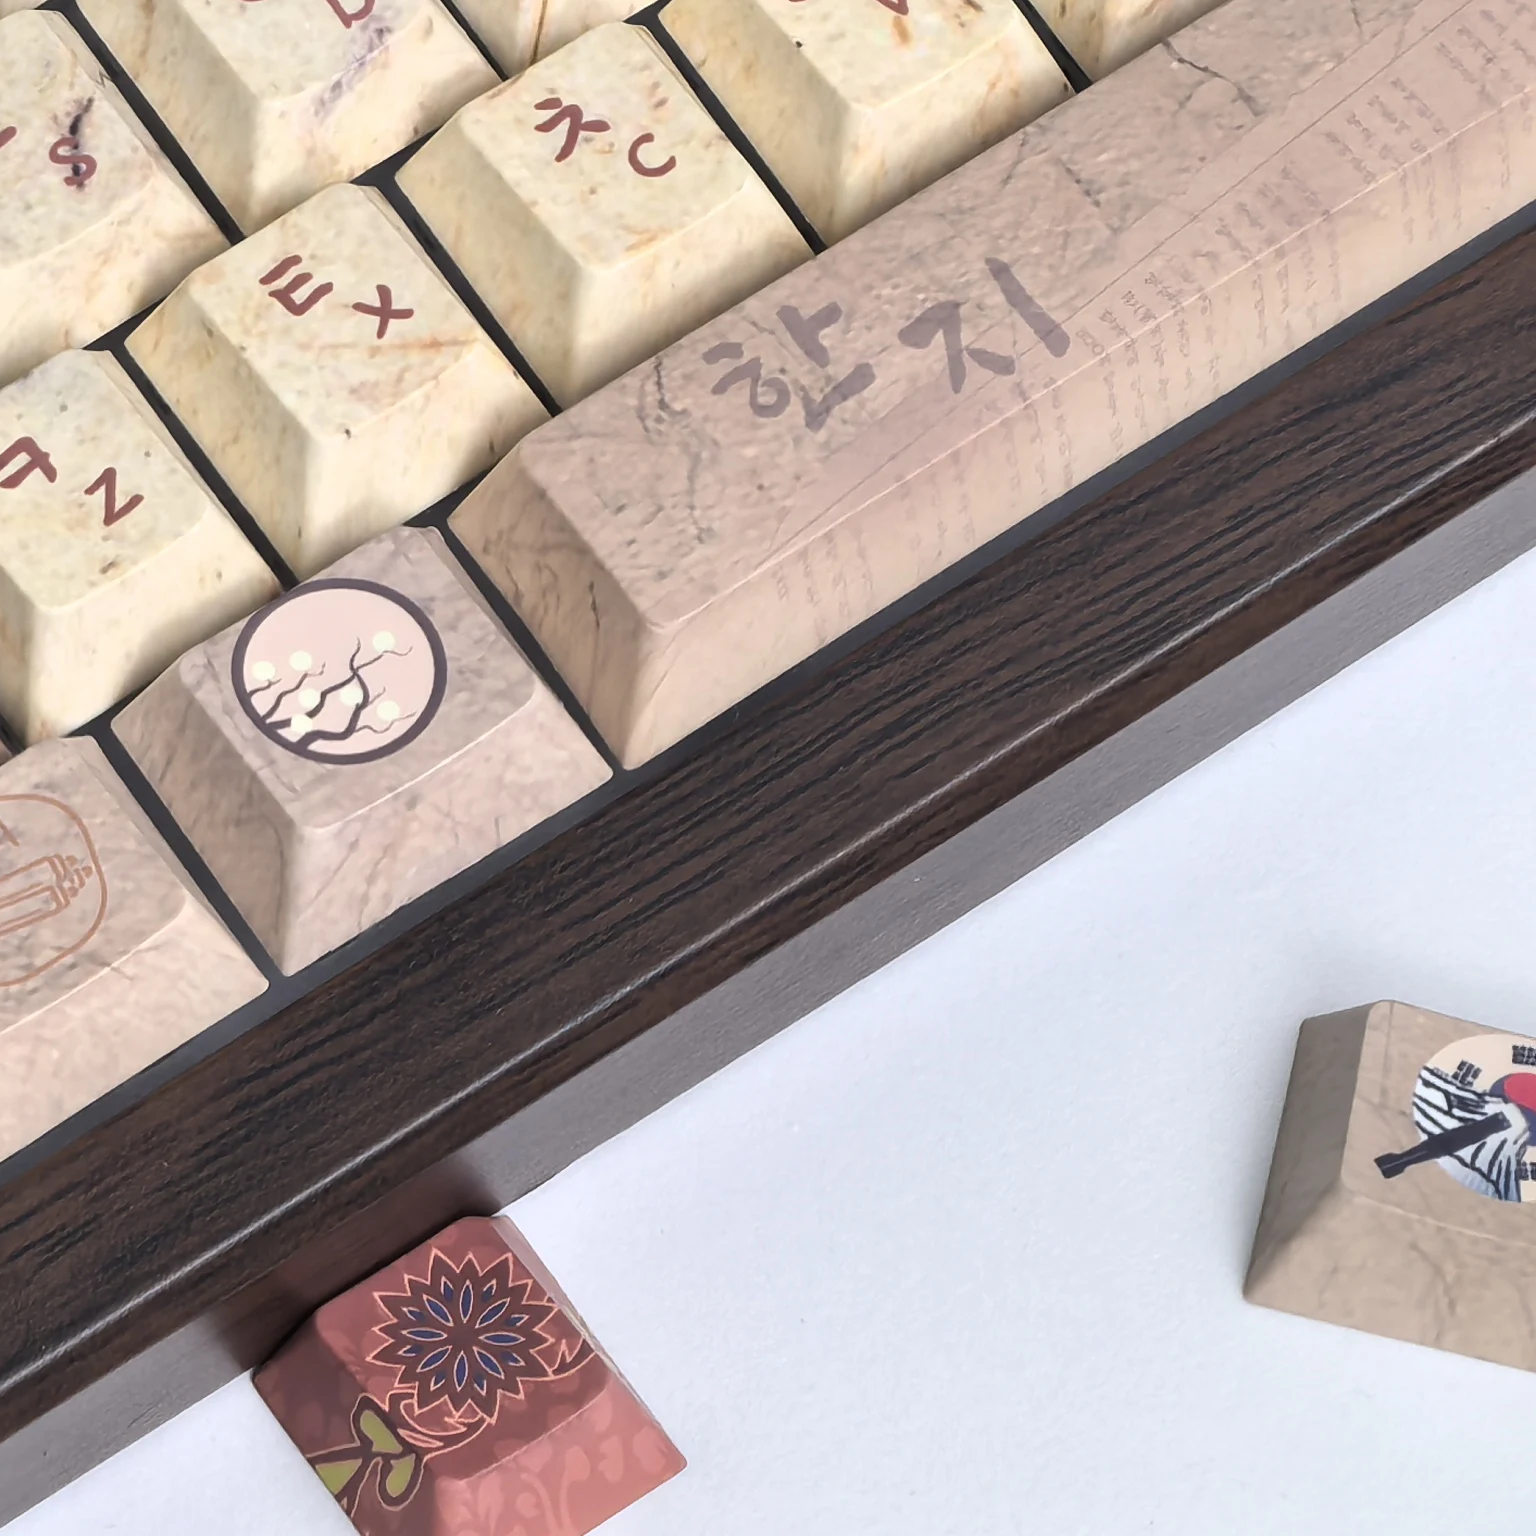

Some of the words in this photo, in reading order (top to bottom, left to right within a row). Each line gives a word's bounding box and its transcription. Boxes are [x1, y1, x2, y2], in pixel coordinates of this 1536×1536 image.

[47, 135, 98, 187] S
[627, 131, 677, 178] C
[350, 285, 415, 340] X
[702, 256, 1071, 433] 한지
[83, 466, 144, 527] Z
